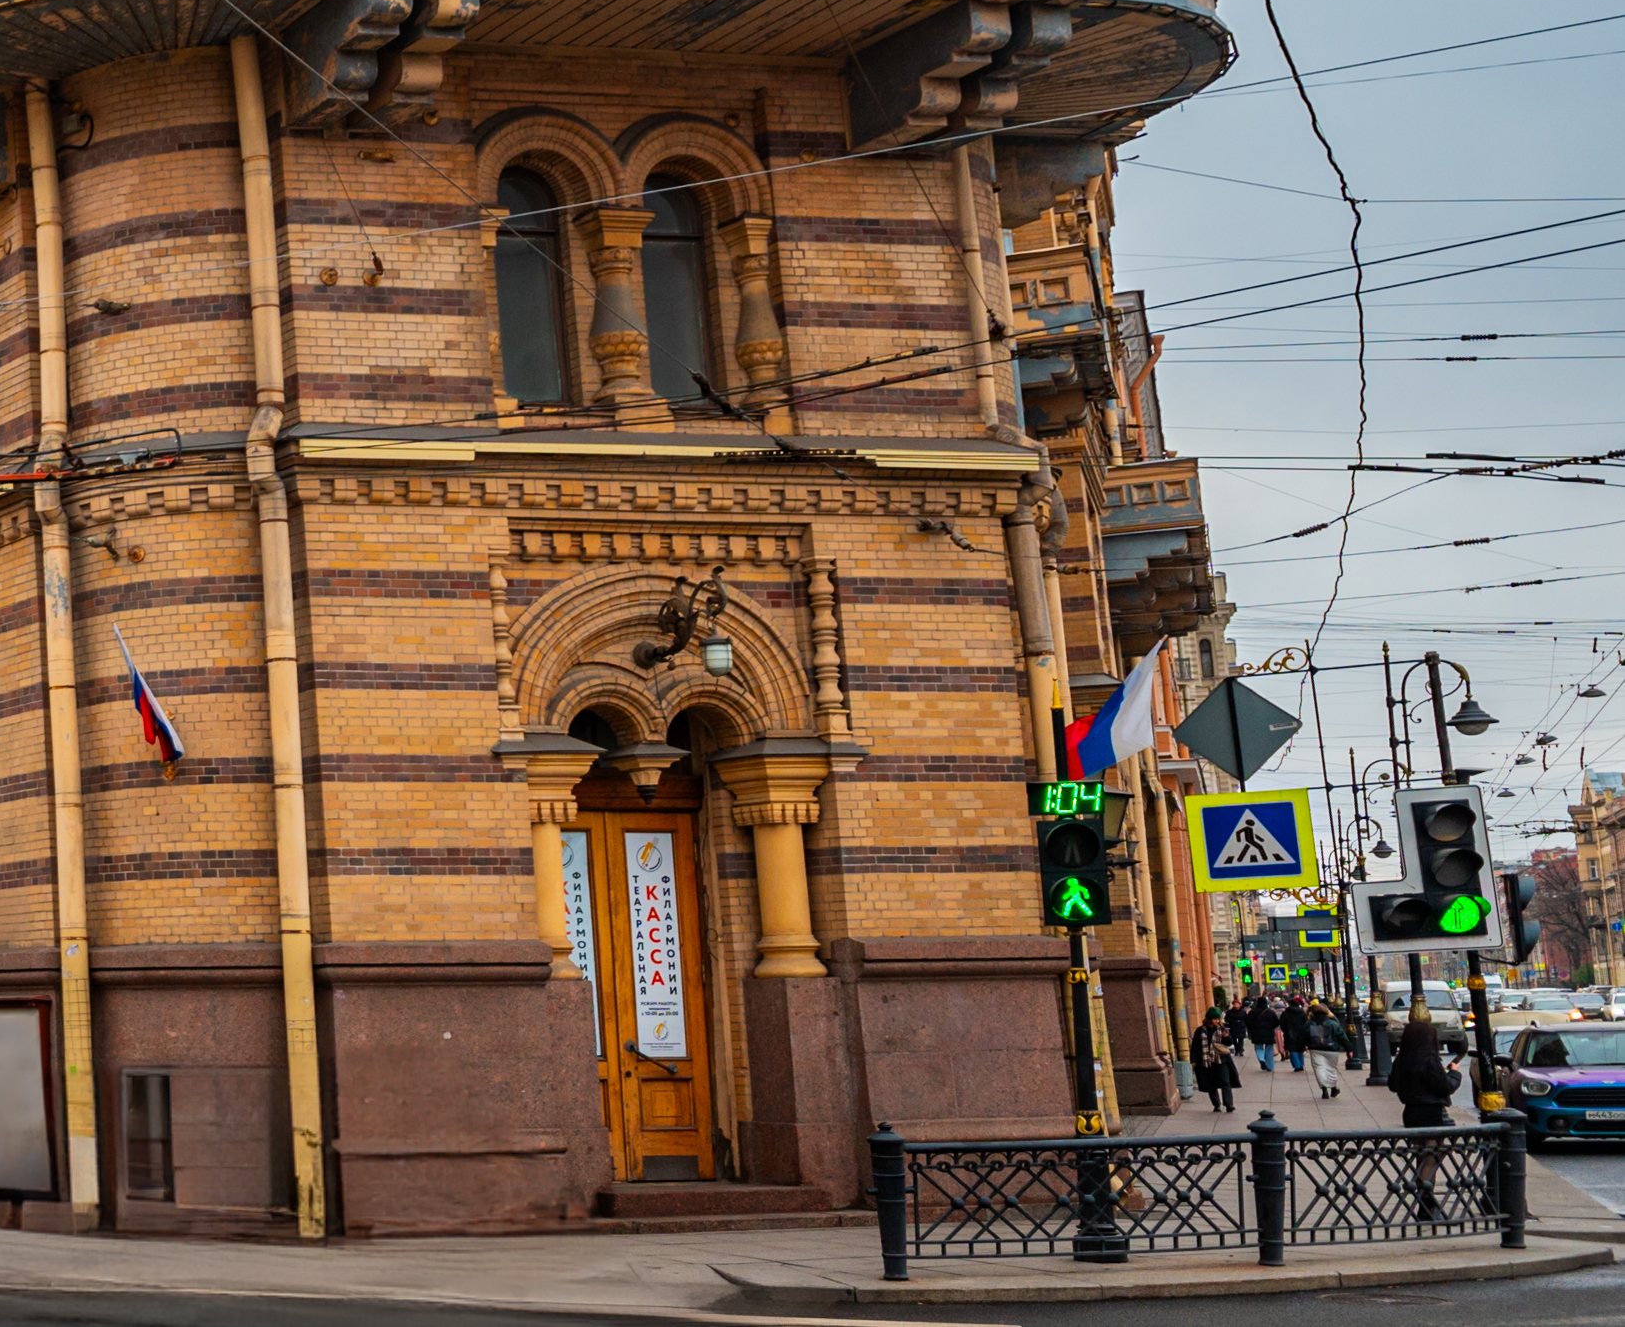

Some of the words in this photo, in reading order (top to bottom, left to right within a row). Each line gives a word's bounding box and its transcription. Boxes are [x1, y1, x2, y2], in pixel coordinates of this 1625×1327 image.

[1044, 783, 1102, 813] 1:04
[633, 875, 647, 995] ТЕАТРАЛЬНАЯ
[646, 885, 665, 986] КАССА
[661, 875, 677, 995] ФИЛАРМОНИИ
